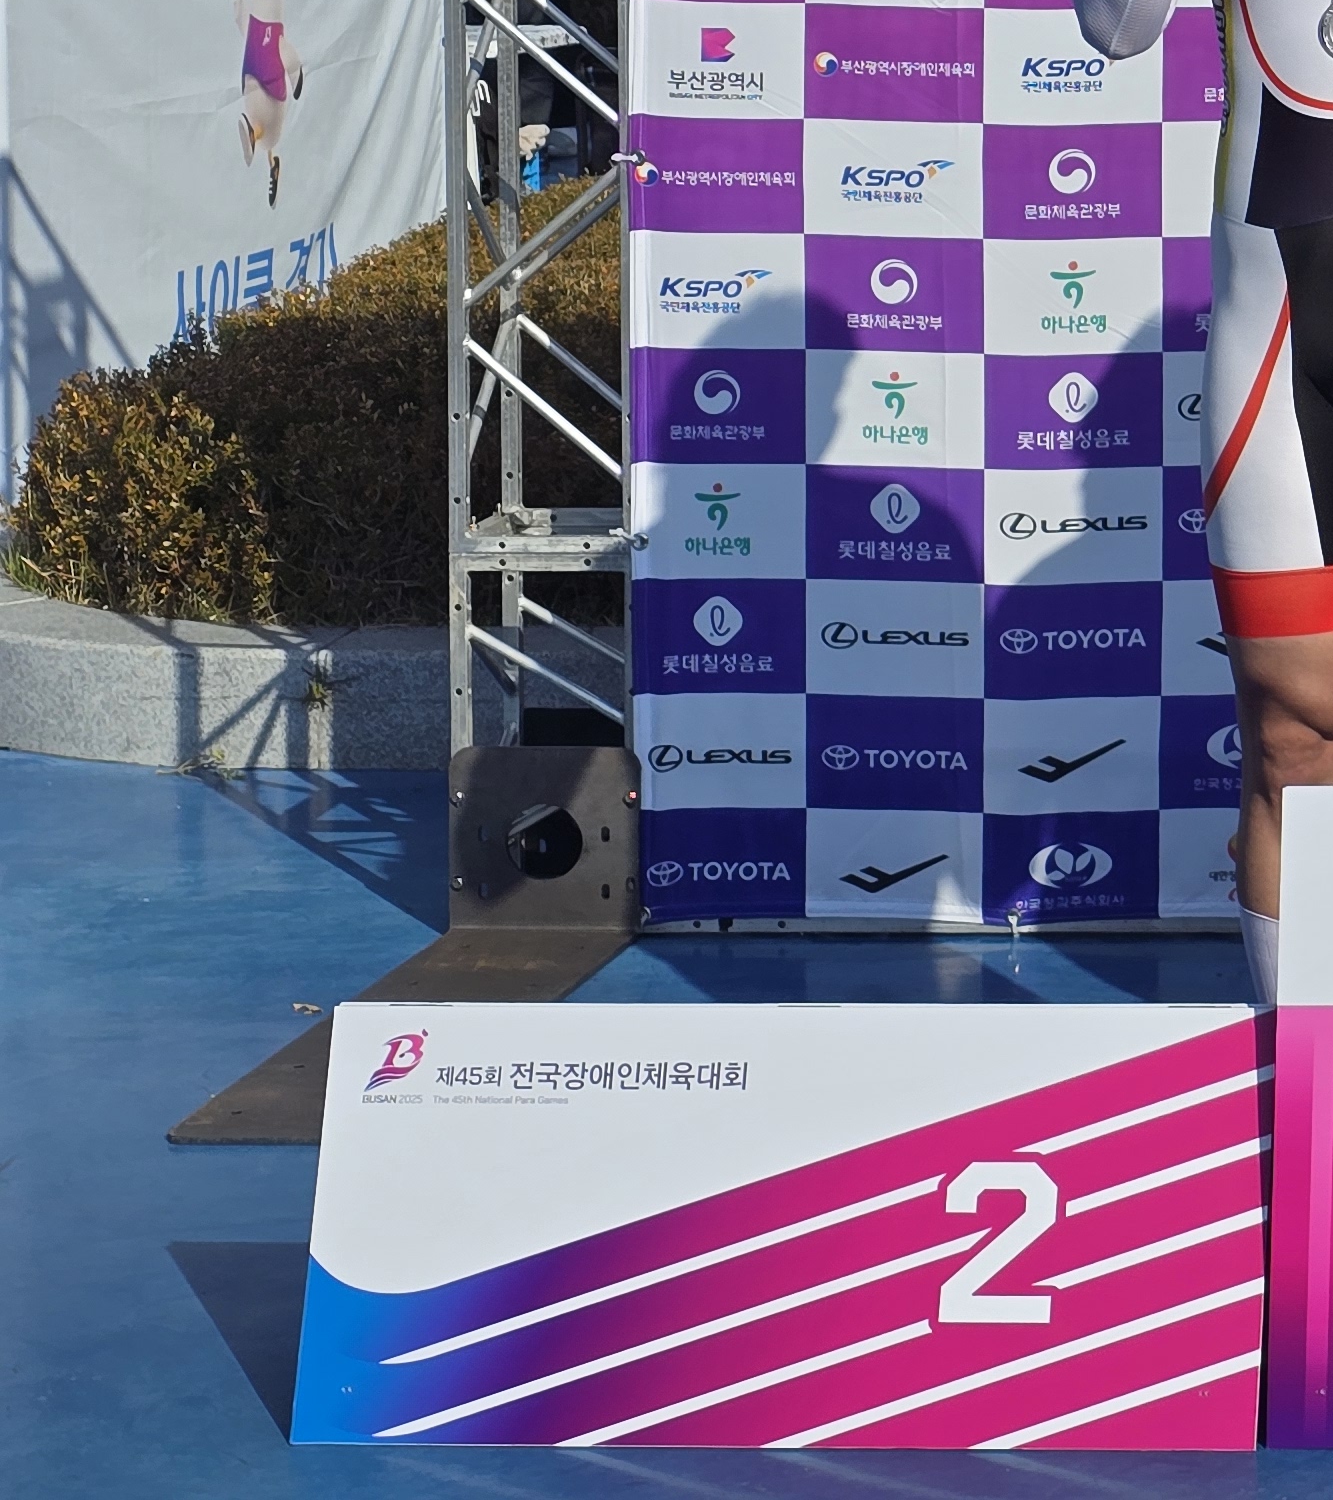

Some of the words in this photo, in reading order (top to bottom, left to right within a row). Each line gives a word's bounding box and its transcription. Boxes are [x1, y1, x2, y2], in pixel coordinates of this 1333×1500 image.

[840, 58, 976, 78] 부산광역시장애인체육회
[1021, 56, 1106, 77] KSPO
[668, 69, 764, 92] 부산광역시
[661, 168, 796, 187] 부산광역시장애인체육회
[841, 165, 925, 188] KSPO
[1024, 202, 1121, 221] 문화체육관광부
[660, 276, 743, 298] KSPO
[846, 312, 943, 331] 문화체육관광부
[1041, 314, 1107, 334] 하나은행
[669, 424, 766, 442] 문화체육관광부
[862, 424, 929, 446] 하나은행
[1016, 429, 1131, 451] 롯데칠성음료
[1040, 514, 1149, 532] LEXUS
[684, 536, 751, 557] 하나은행
[837, 540, 952, 562] 롯데칠성음료
[862, 628, 970, 648] LEXUS
[1042, 628, 1147, 651] TOYOTA
[662, 653, 775, 675] 롯데칠성음료
[686, 748, 793, 766] LEXUS
[863, 748, 968, 772] TOYOTA
[688, 861, 791, 883] TOYOTA
[435, 1064, 503, 1088] 제45회
[509, 1059, 748, 1092] 전국장애인체육대회
[361, 1094, 397, 1104] BUSAN
[938, 1160, 1060, 1325] 2
